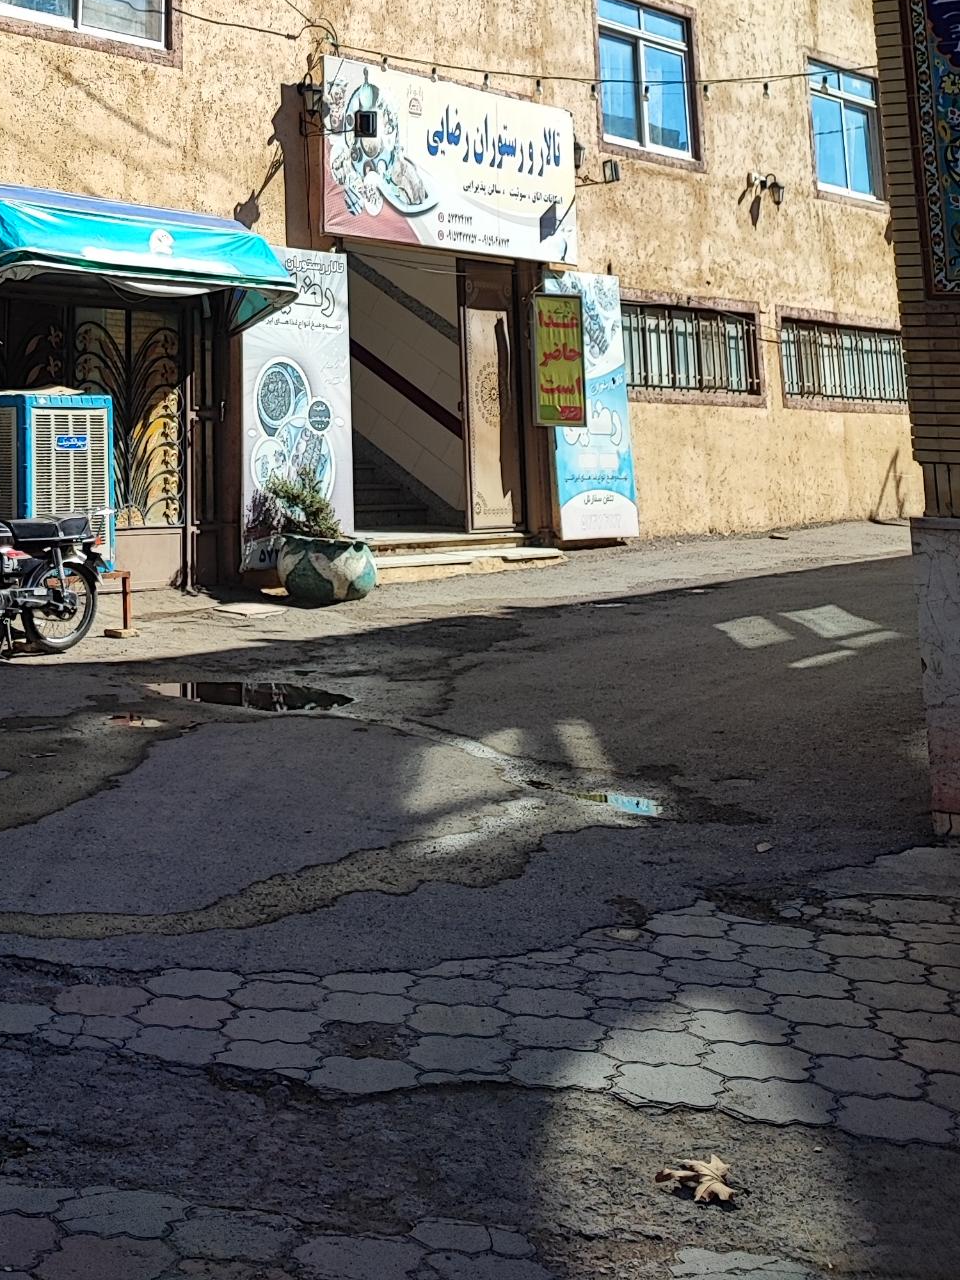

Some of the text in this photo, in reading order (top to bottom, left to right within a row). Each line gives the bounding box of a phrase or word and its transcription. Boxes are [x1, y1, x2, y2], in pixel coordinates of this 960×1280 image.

[426, 103, 469, 163] رضایی
[473, 113, 524, 173] رستوران
[538, 126, 560, 177] تالار
